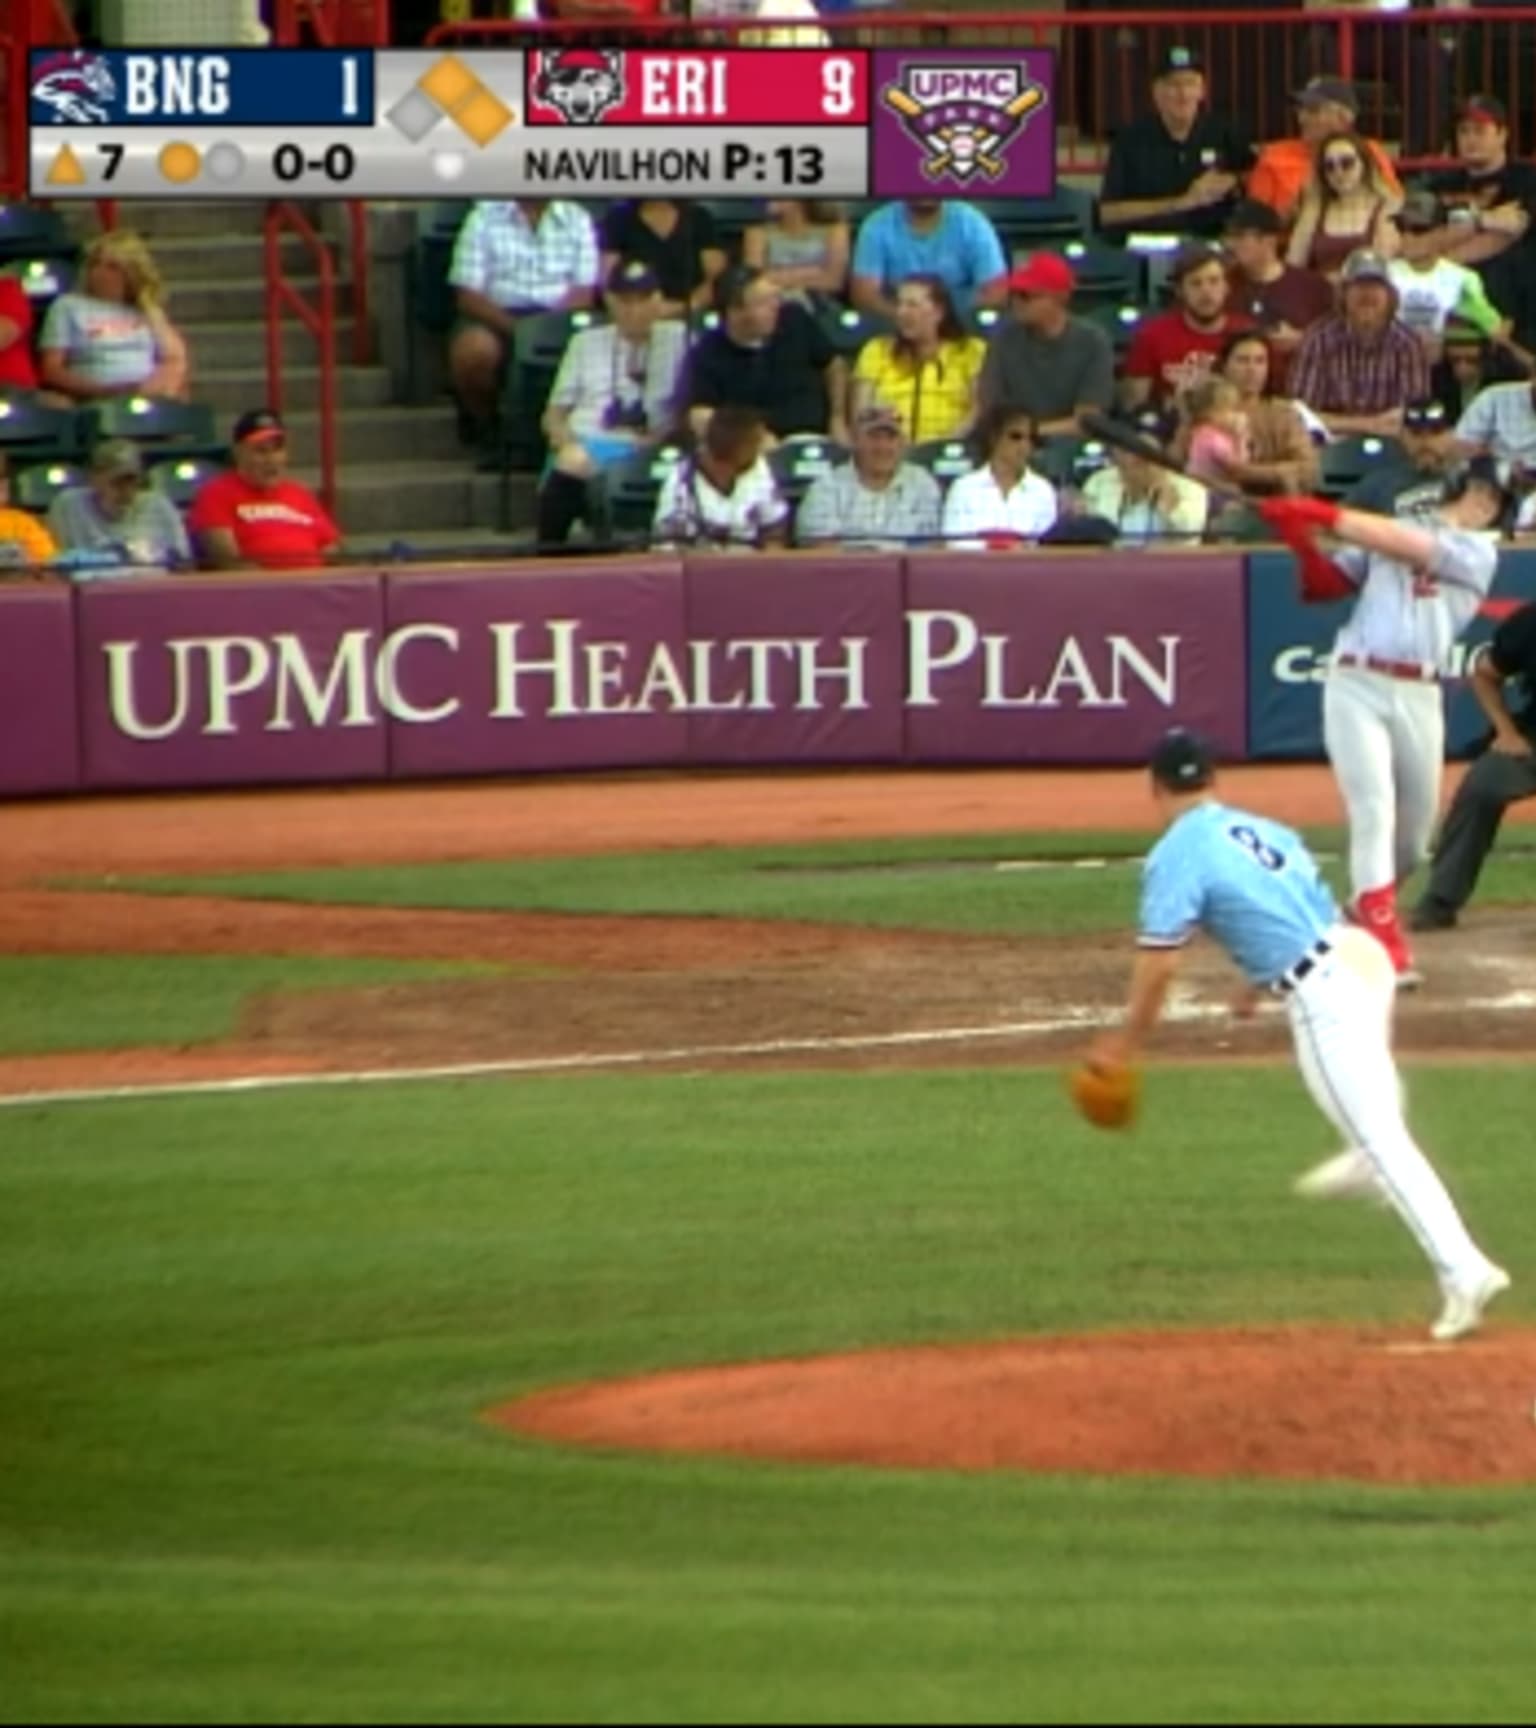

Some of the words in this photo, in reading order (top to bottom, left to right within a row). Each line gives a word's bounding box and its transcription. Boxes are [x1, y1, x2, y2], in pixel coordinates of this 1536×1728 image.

[104, 622, 460, 739] UPMC
[489, 620, 870, 718] HEALTH
[905, 610, 1180, 707] PLAN
[1228, 824, 1286, 872] 8
